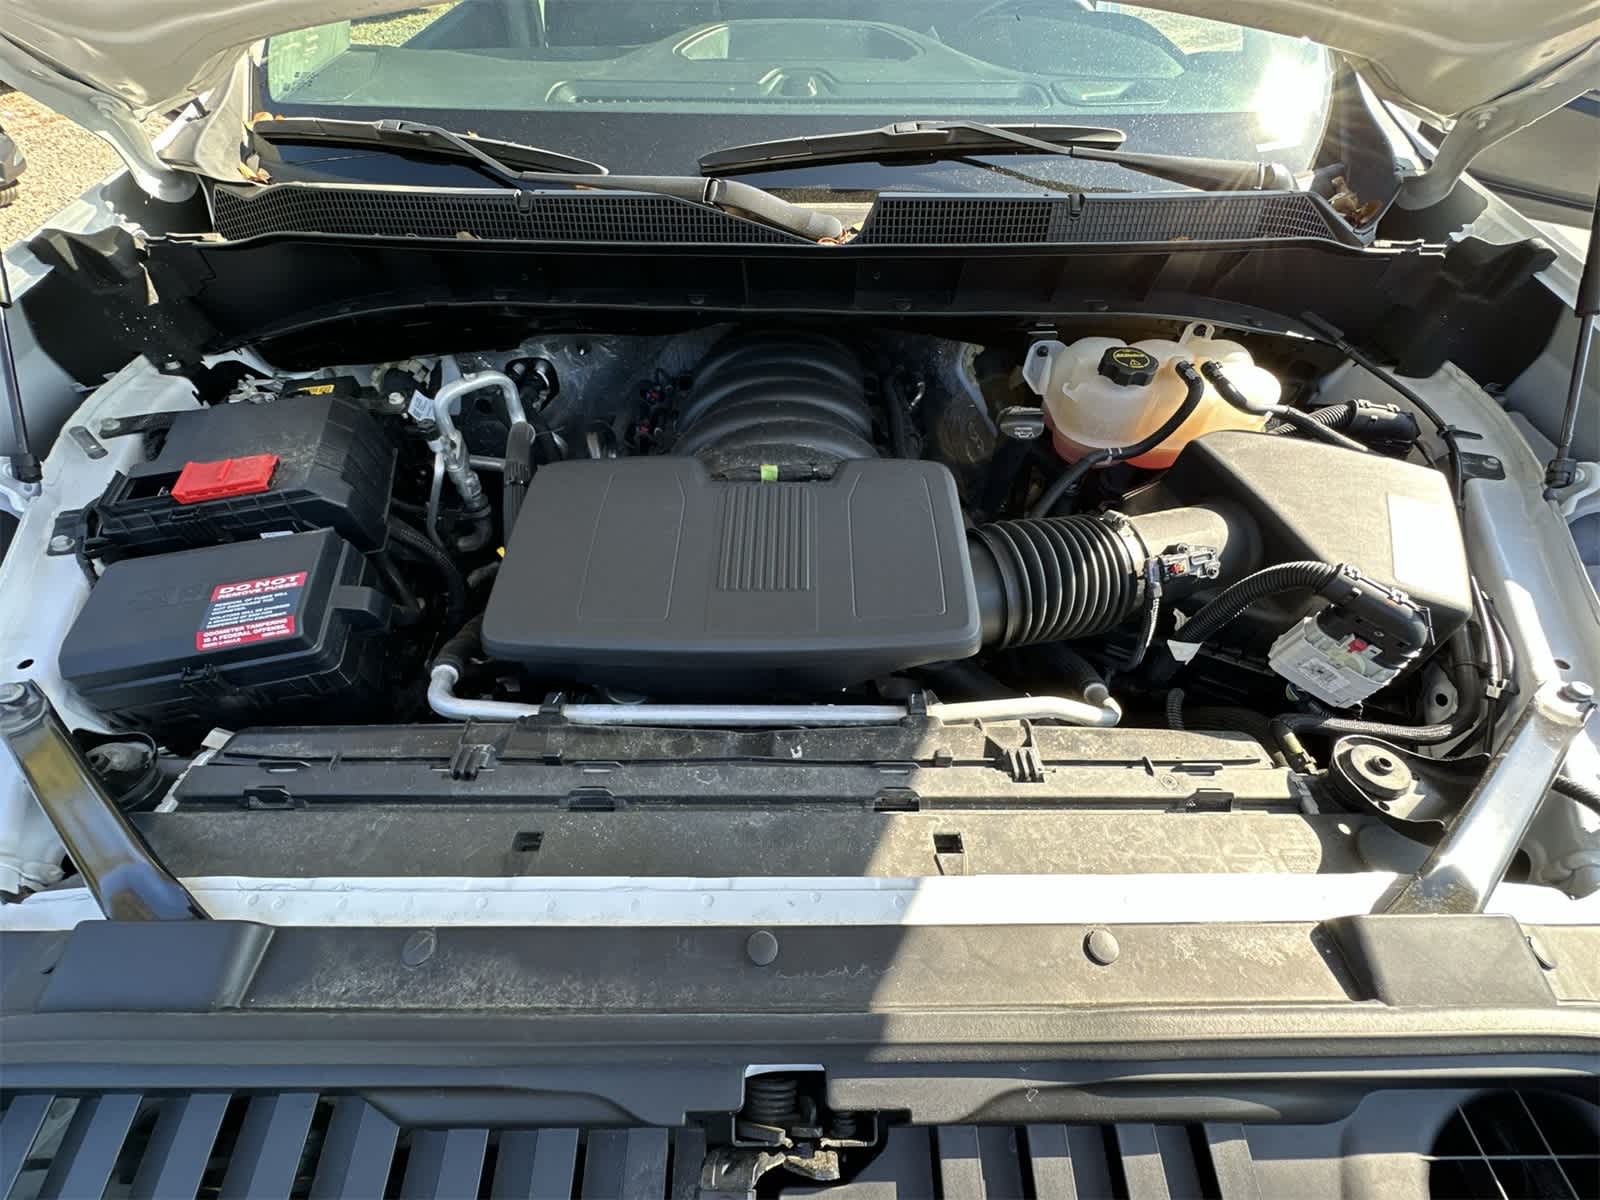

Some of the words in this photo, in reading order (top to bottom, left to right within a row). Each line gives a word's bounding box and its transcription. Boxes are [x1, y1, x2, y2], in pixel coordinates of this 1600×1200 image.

[217, 588, 261, 599] REMOVE
[264, 582, 298, 592] FUSES
[219, 584, 251, 595] DO
[255, 575, 300, 588] NOT
[203, 625, 246, 637] ODOMETER
[246, 617, 288, 630] TAMPERING
[219, 630, 252, 641] FEDERAL
